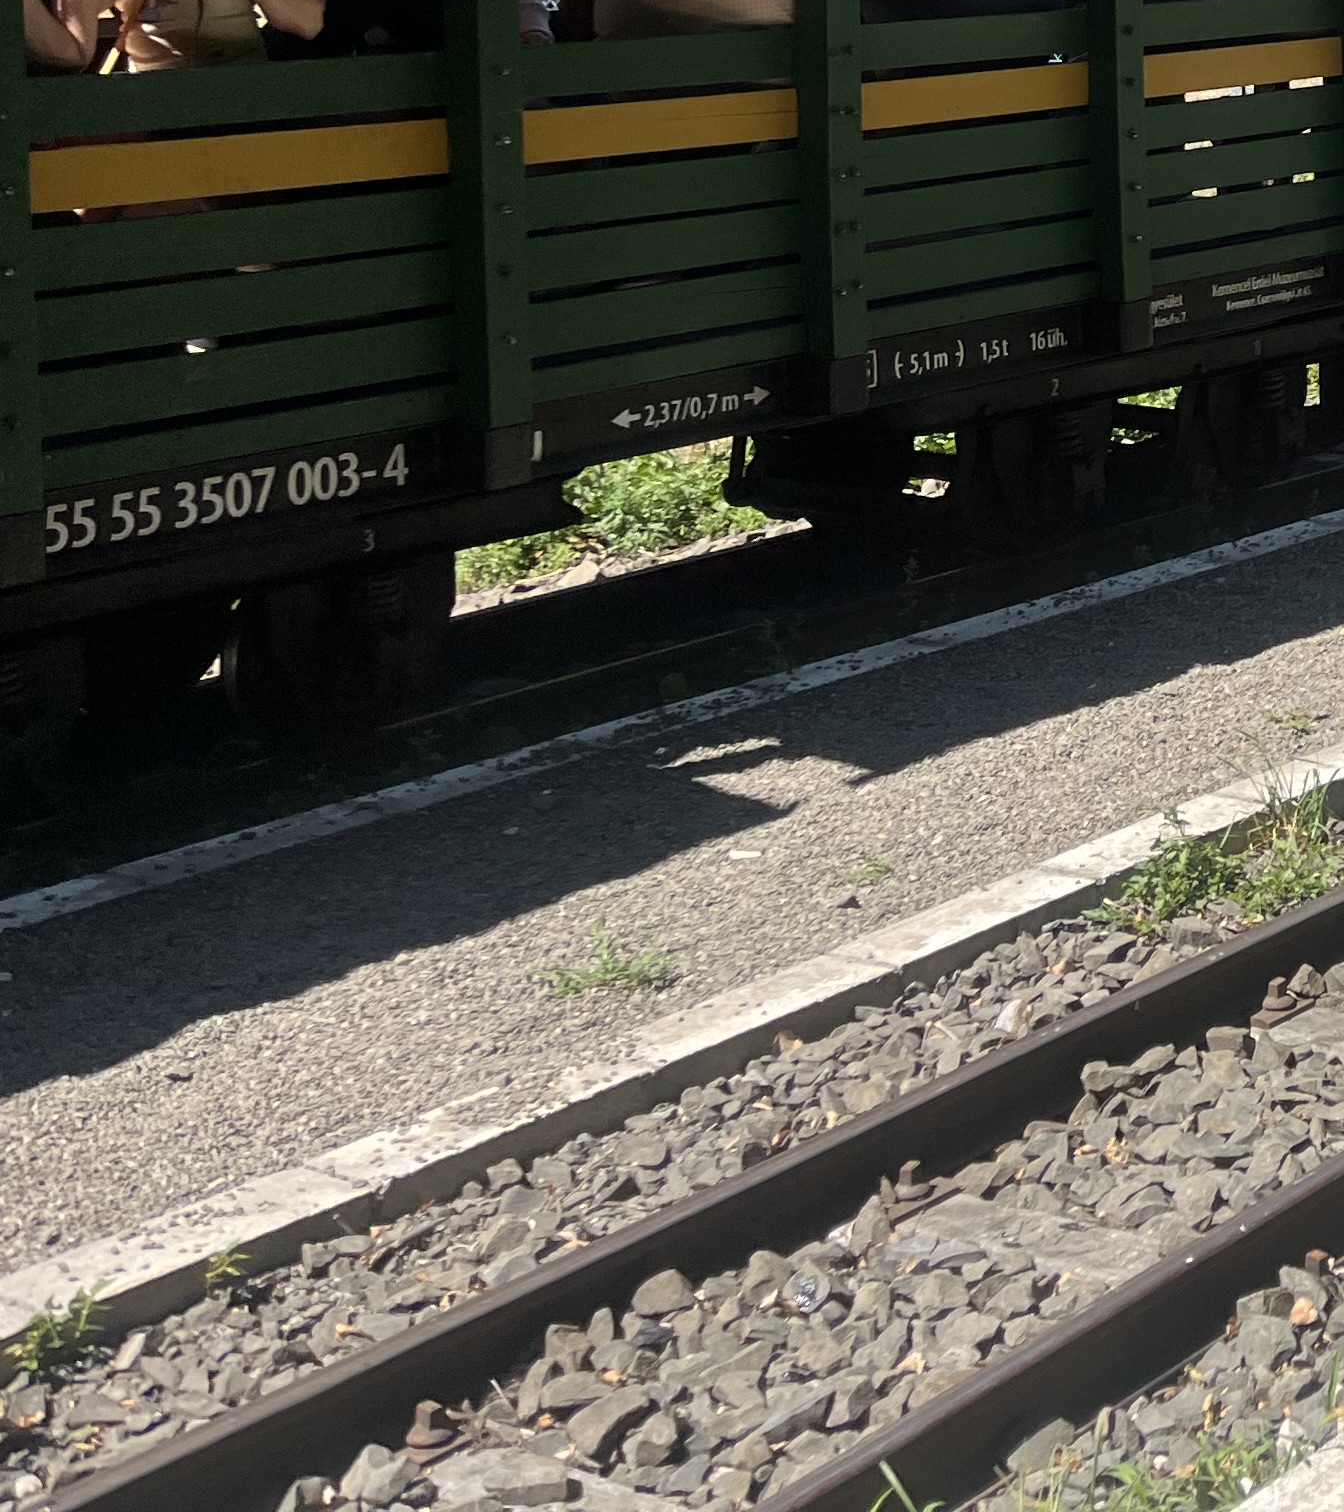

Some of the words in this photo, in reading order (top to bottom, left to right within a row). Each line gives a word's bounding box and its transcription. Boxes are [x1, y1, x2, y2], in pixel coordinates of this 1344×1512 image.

[1051, 378, 1060, 397] 2
[643, 393, 718, 429] 2,37/0,7
[721, 393, 740, 413] m
[45, 498, 98, 554] 55
[109, 486, 163, 543] 55
[173, 466, 277, 530] 3507
[287, 442, 410, 507] 003-4
[363, 528, 377, 553] 3
